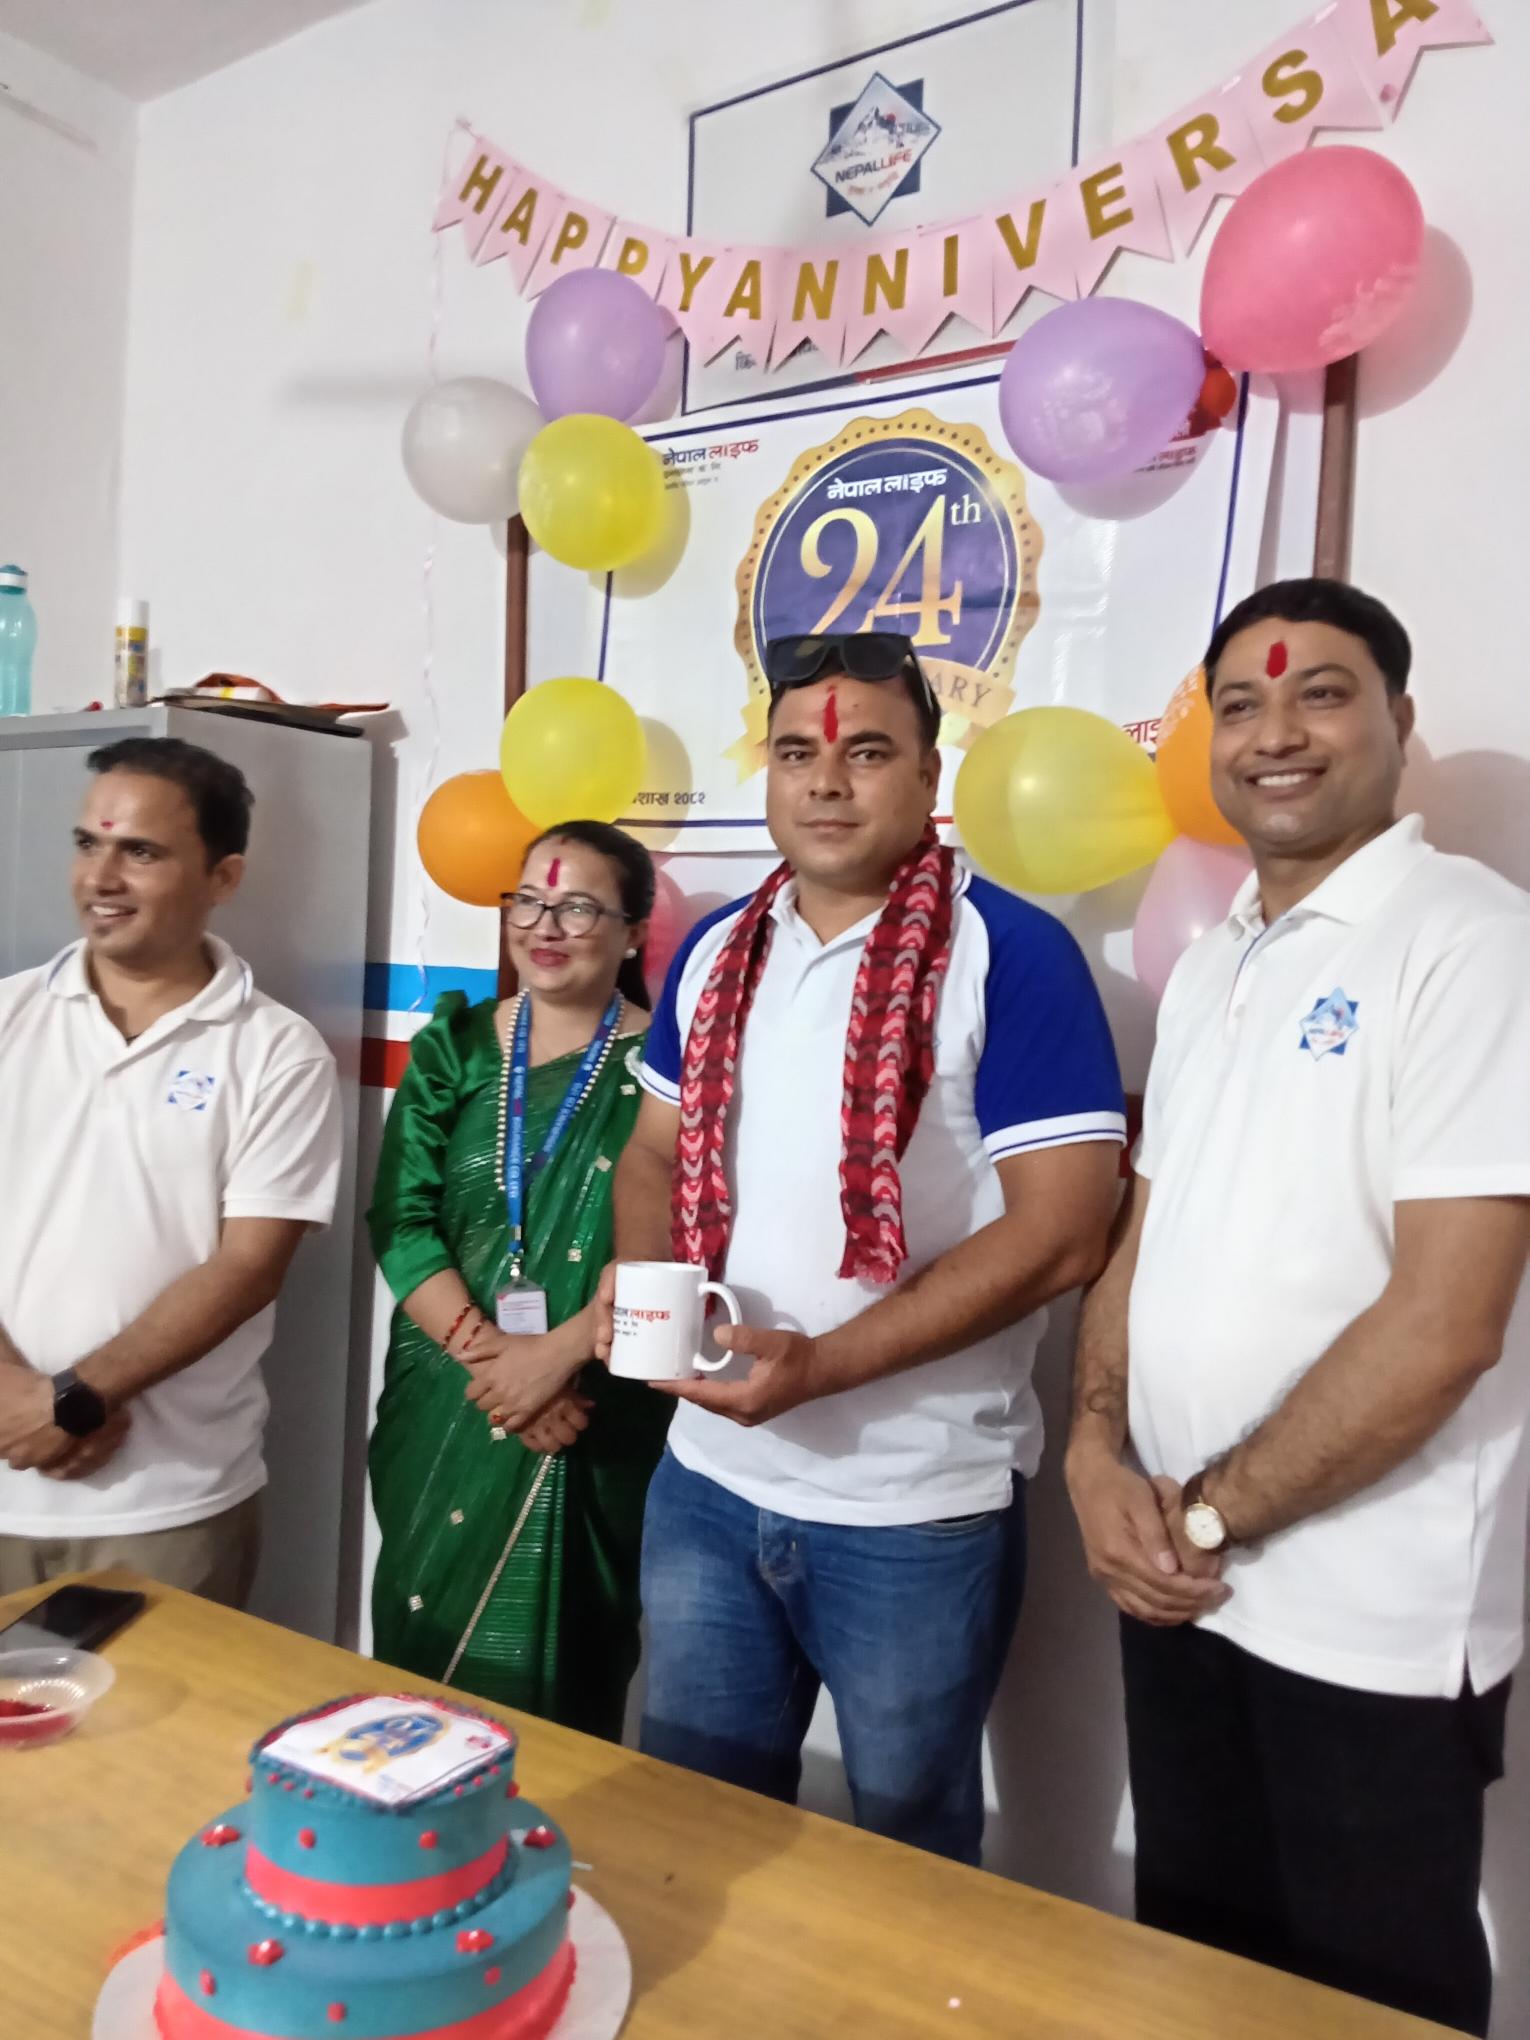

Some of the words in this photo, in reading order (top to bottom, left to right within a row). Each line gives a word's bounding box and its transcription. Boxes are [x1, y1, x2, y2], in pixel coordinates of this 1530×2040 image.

[826, 477, 882, 499] नेपाल
[884, 468, 948, 494] लाइफ
[632, 791, 671, 806] शाख
